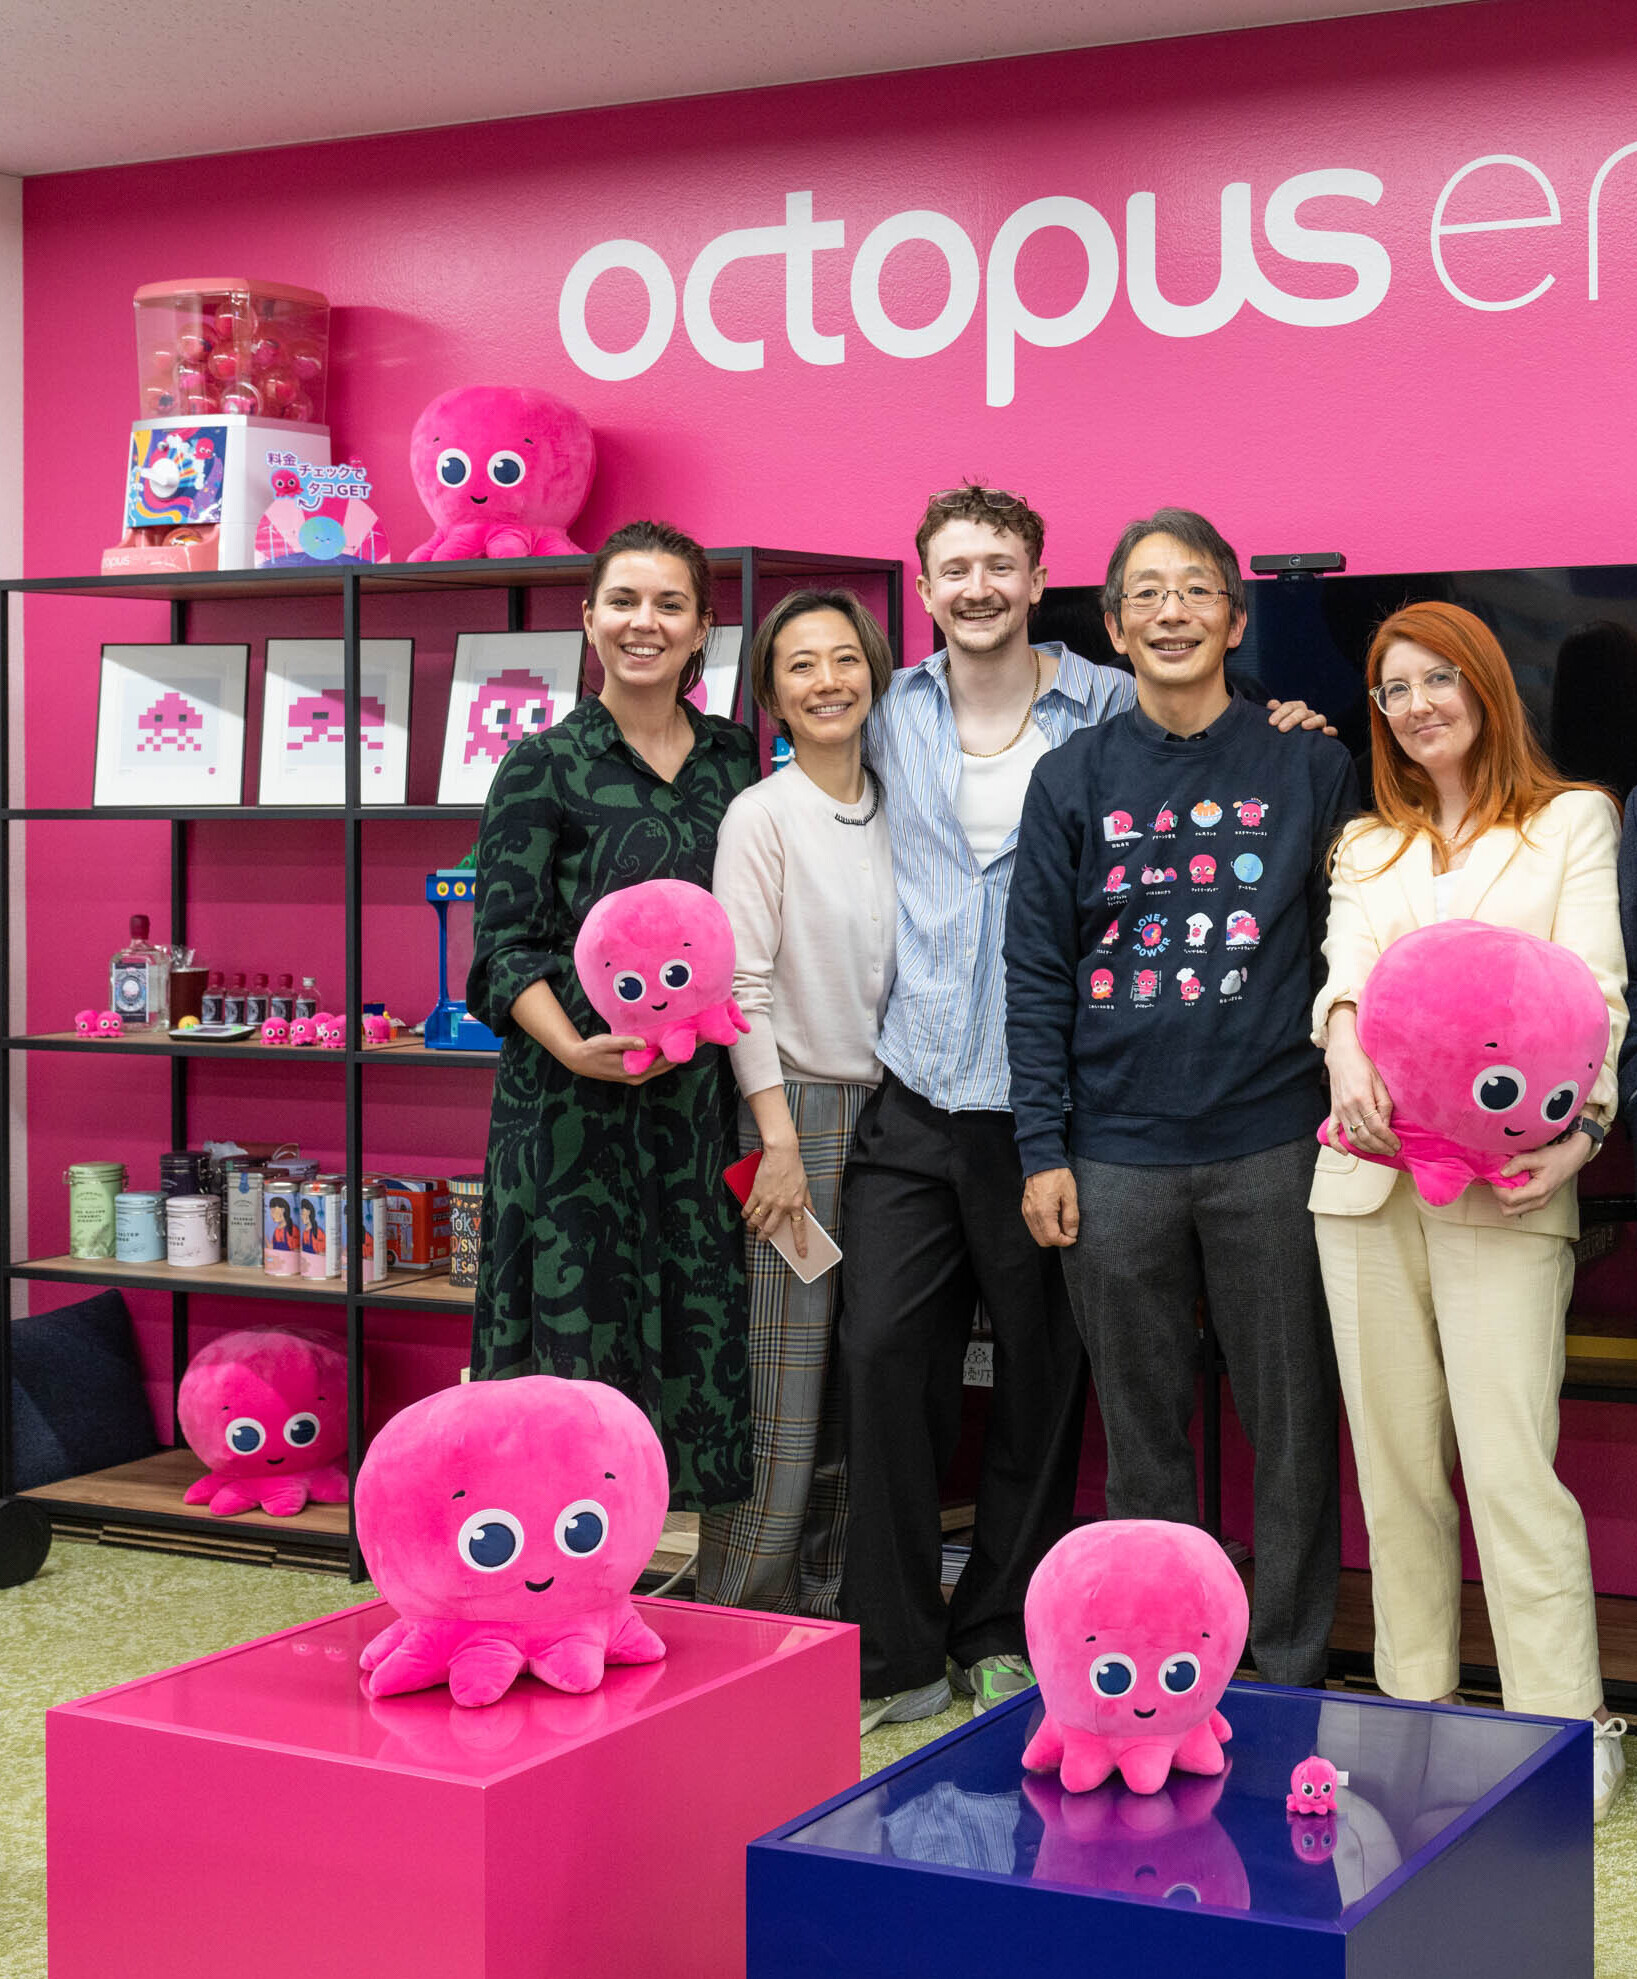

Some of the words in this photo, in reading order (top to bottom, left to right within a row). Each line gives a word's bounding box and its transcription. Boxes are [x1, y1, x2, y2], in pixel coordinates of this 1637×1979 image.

[559, 168, 1392, 408] octopus
[267, 452, 297, 466] 料金
[299, 463, 364, 480] チェックで
[308, 481, 369, 497] タコGET
[1133, 913, 1161, 933] LOVE
[1160, 917, 1169, 926] &
[1132, 937, 1172, 957] POWER
